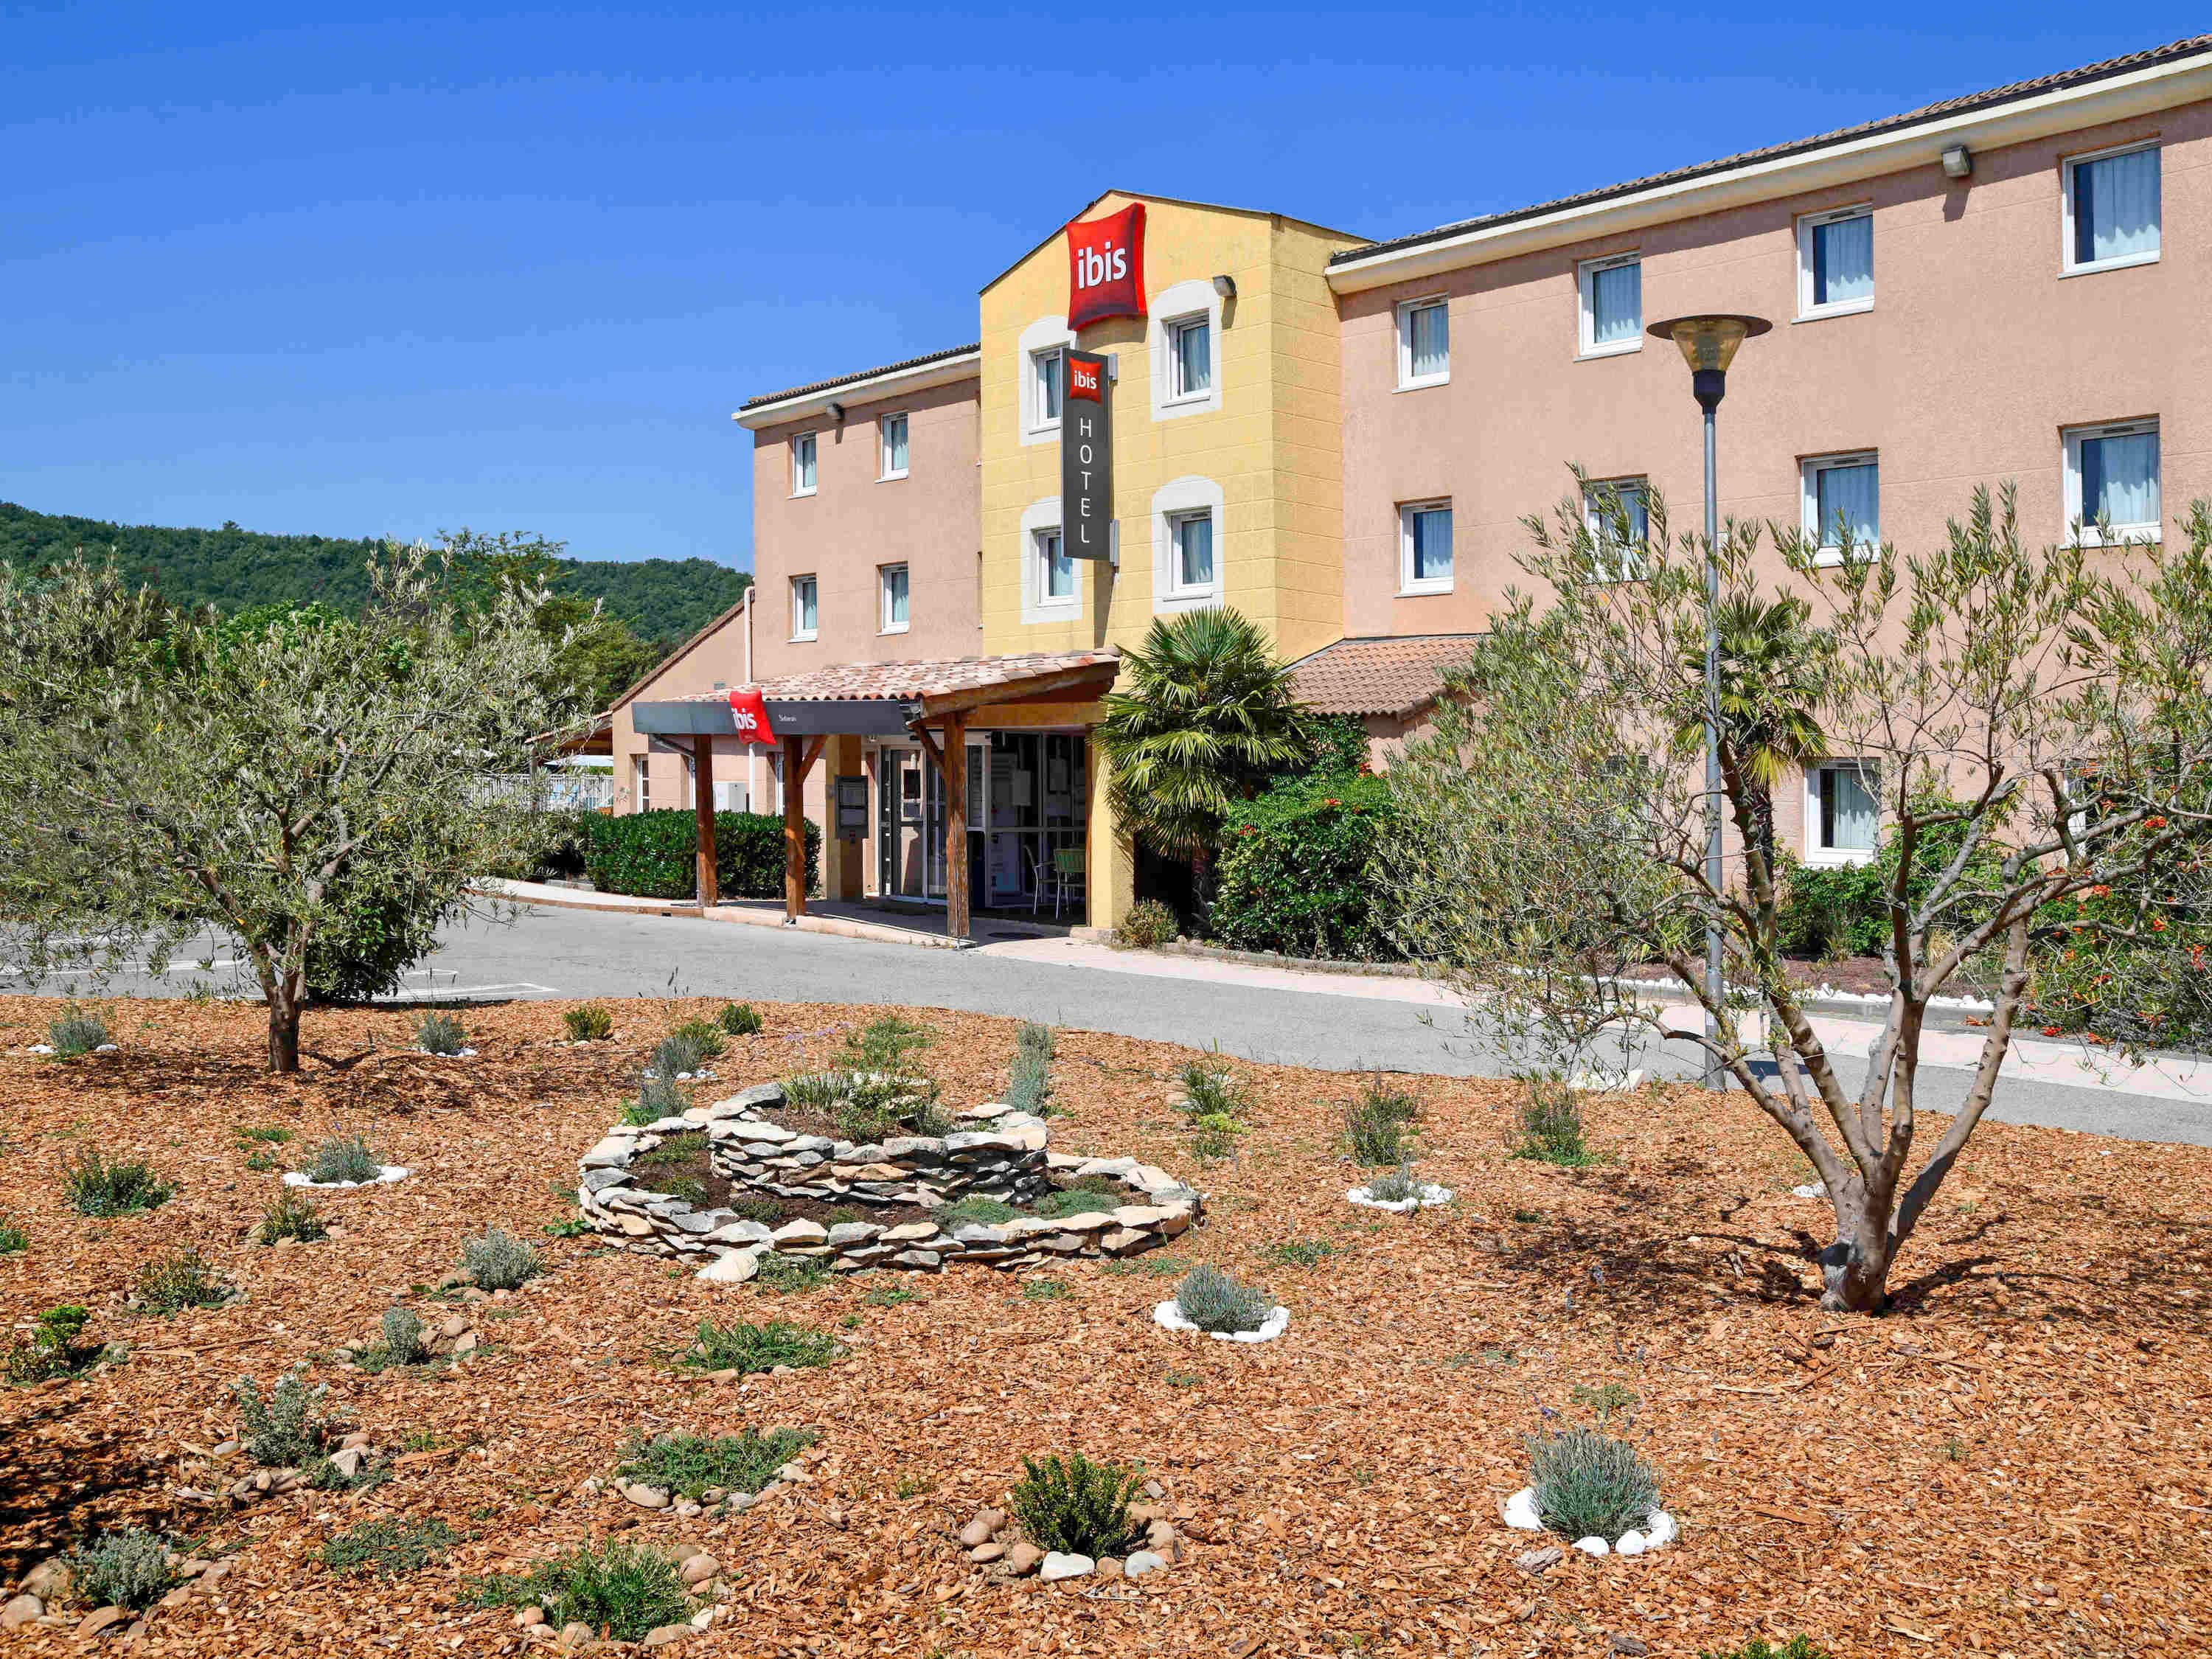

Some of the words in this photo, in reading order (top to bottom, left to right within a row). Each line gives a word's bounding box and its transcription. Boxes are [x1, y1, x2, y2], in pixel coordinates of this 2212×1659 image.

[1078, 241, 1127, 289] ibis
[1074, 369, 1097, 390] ibis
[1079, 417, 1093, 543] HOTEL
[731, 707, 757, 730] ibis
